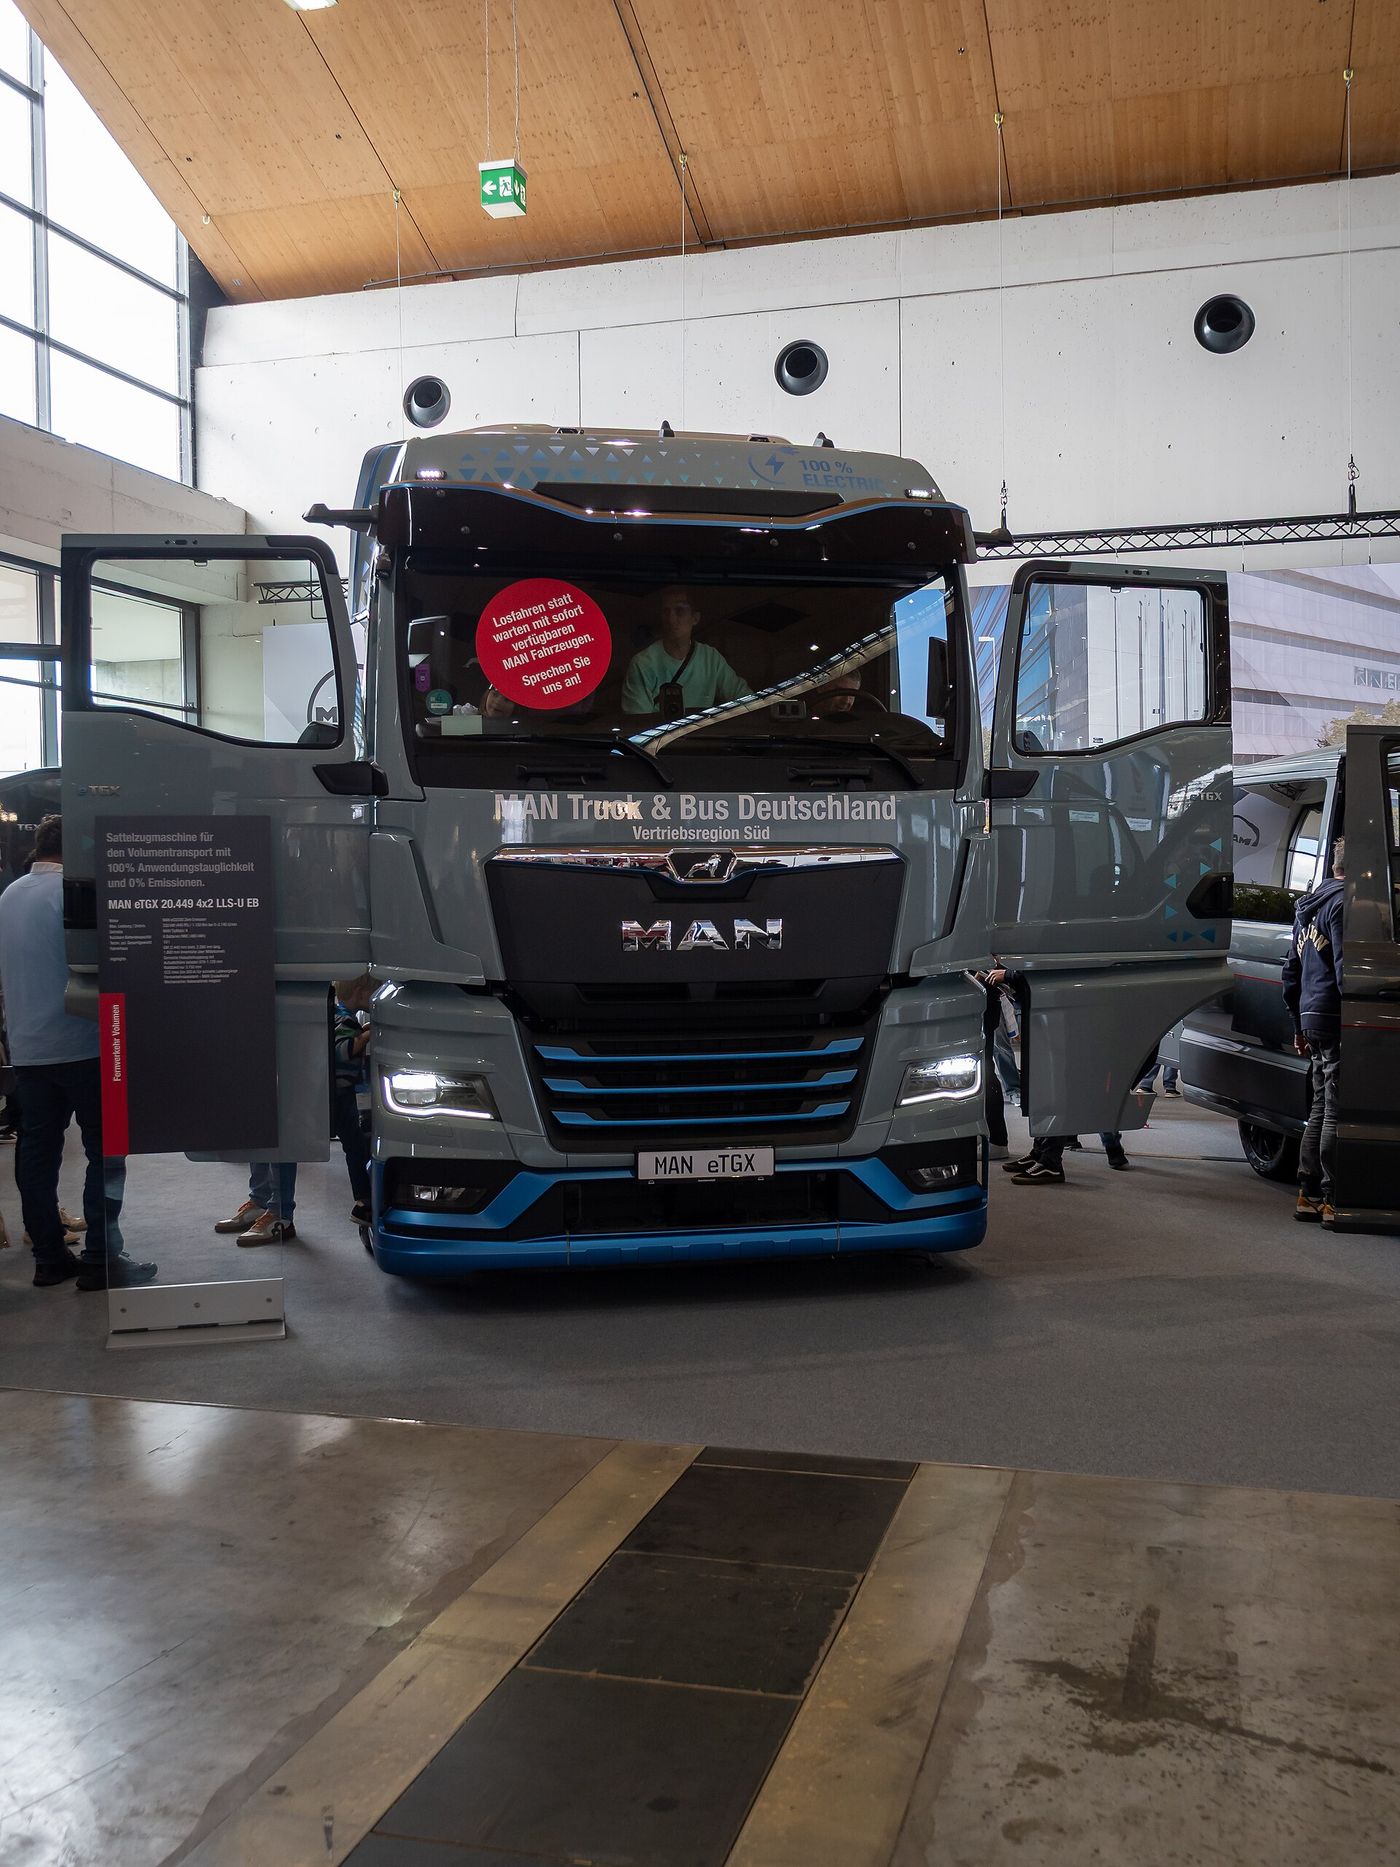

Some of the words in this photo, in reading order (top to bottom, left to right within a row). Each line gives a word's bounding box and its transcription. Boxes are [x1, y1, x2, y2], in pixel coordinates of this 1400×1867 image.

[799, 460, 830, 473] 100
[835, 461, 853, 473] %
[492, 603, 546, 627] Losfahren
[548, 593, 574, 609] statt
[492, 624, 531, 643] warten
[532, 616, 551, 630] mit
[552, 605, 584, 623] sofort
[511, 623, 575, 652] verfügbaren
[502, 653, 530, 670] MAN
[530, 634, 595, 661] Fahrzeugen.
[522, 663, 572, 686] Sprechen
[573, 655, 591, 669] Sie
[542, 681, 563, 695] uns
[565, 673, 582, 687] an!
[493, 794, 559, 820] MAN
[567, 794, 643, 820] Truck
[651, 794, 670, 820] &
[680, 794, 729, 820] Bus
[738, 794, 897, 821] Deutschland
[106, 832, 198, 844] Sattelzugmaschine
[200, 832, 214, 842] für
[632, 825, 740, 844] Vertriebsregion
[744, 825, 770, 841] Süd
[107, 848, 125, 858] den
[128, 847, 213, 860] Volumentransport
[215, 847, 231, 857] mit
[107, 863, 135, 873] 100%
[137, 861, 255, 874] Anwendungstauglichkeit
[108, 878, 126, 888] und
[129, 878, 146, 888] 0%
[148, 877, 205, 888] Emissionen.
[108, 899, 132, 909] MAN
[134, 899, 159, 909] eTGX
[161, 899, 194, 909] 20.449
[196, 898, 214, 908] 4x2
[216, 898, 244, 908] LLS-U
[247, 898, 260, 908] EB
[621, 917, 784, 952] MAN
[112, 1004, 120, 1036] Volumen
[112, 1038, 121, 1082] Fernverkehr
[654, 1155, 694, 1176] MAN
[707, 1153, 756, 1174] eTGX
